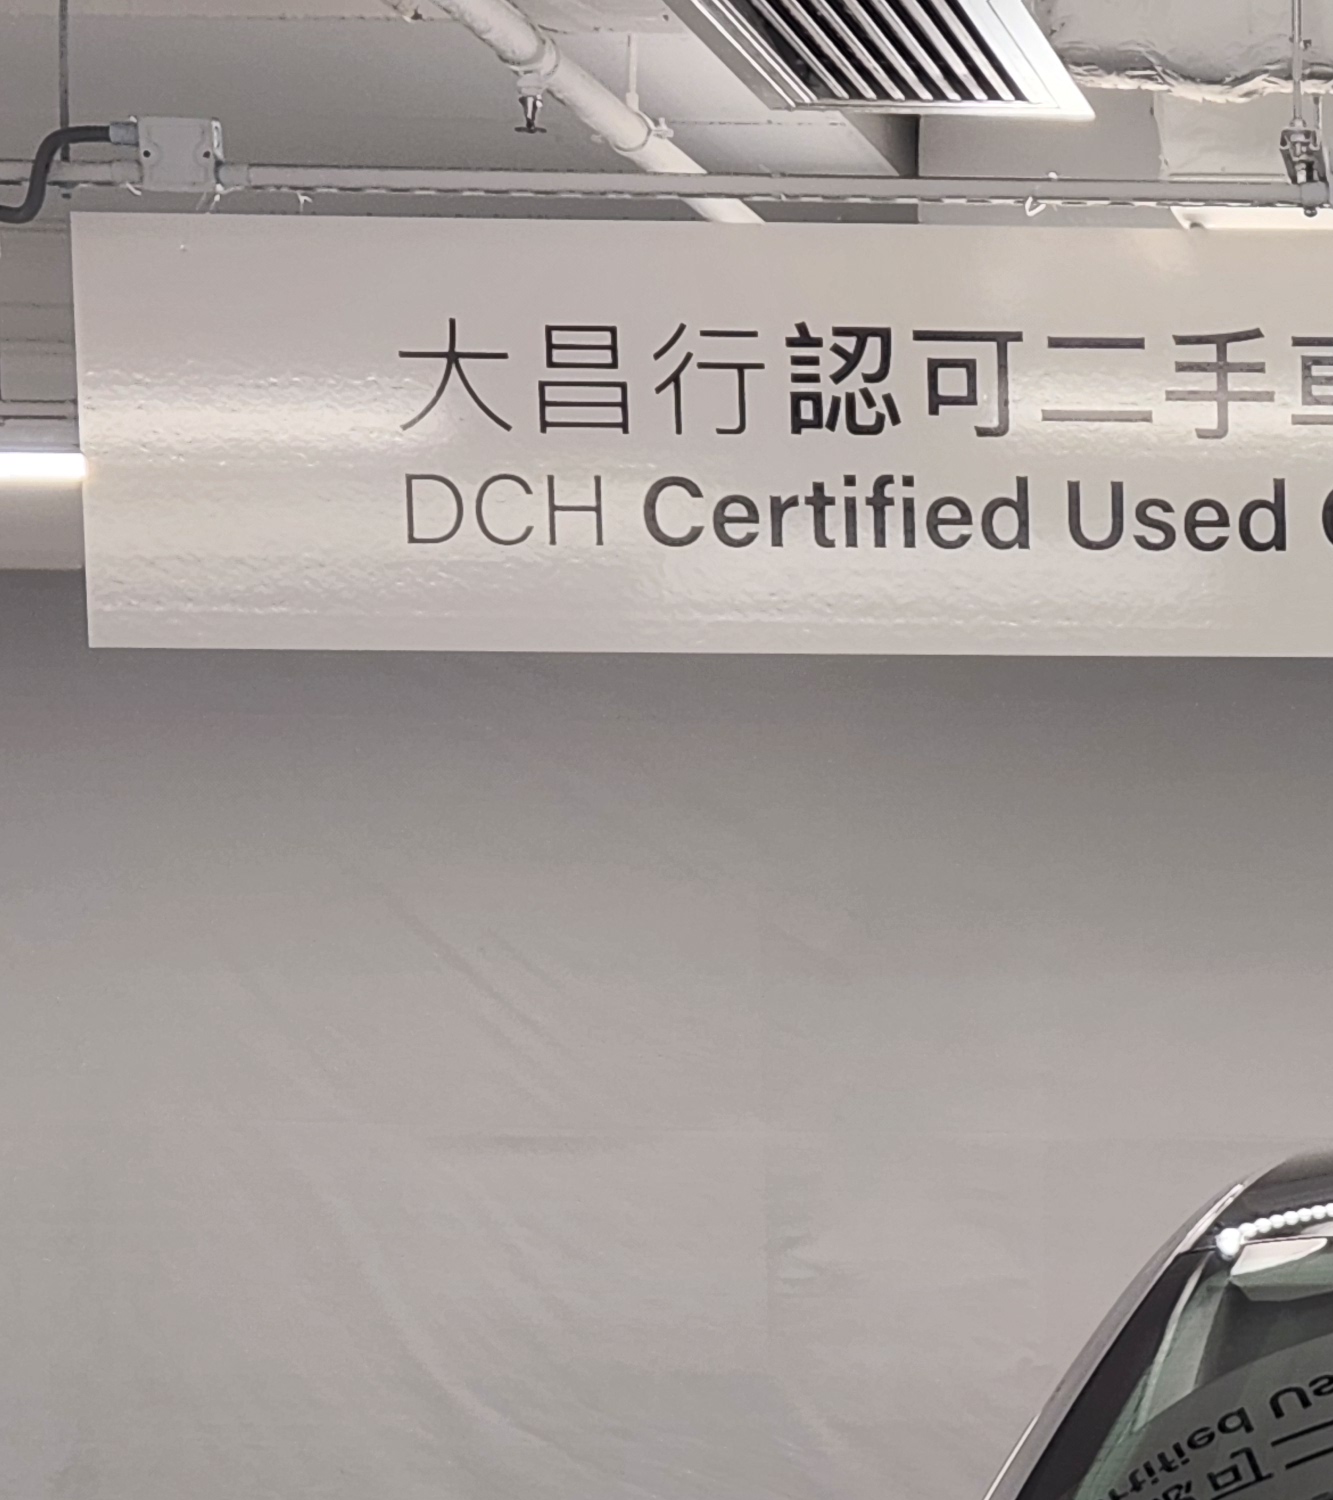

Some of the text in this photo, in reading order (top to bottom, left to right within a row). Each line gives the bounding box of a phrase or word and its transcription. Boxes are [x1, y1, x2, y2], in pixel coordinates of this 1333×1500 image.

[403, 472, 605, 548] DCH
[641, 473, 1032, 553] Certified
[1065, 479, 1288, 555] Used
